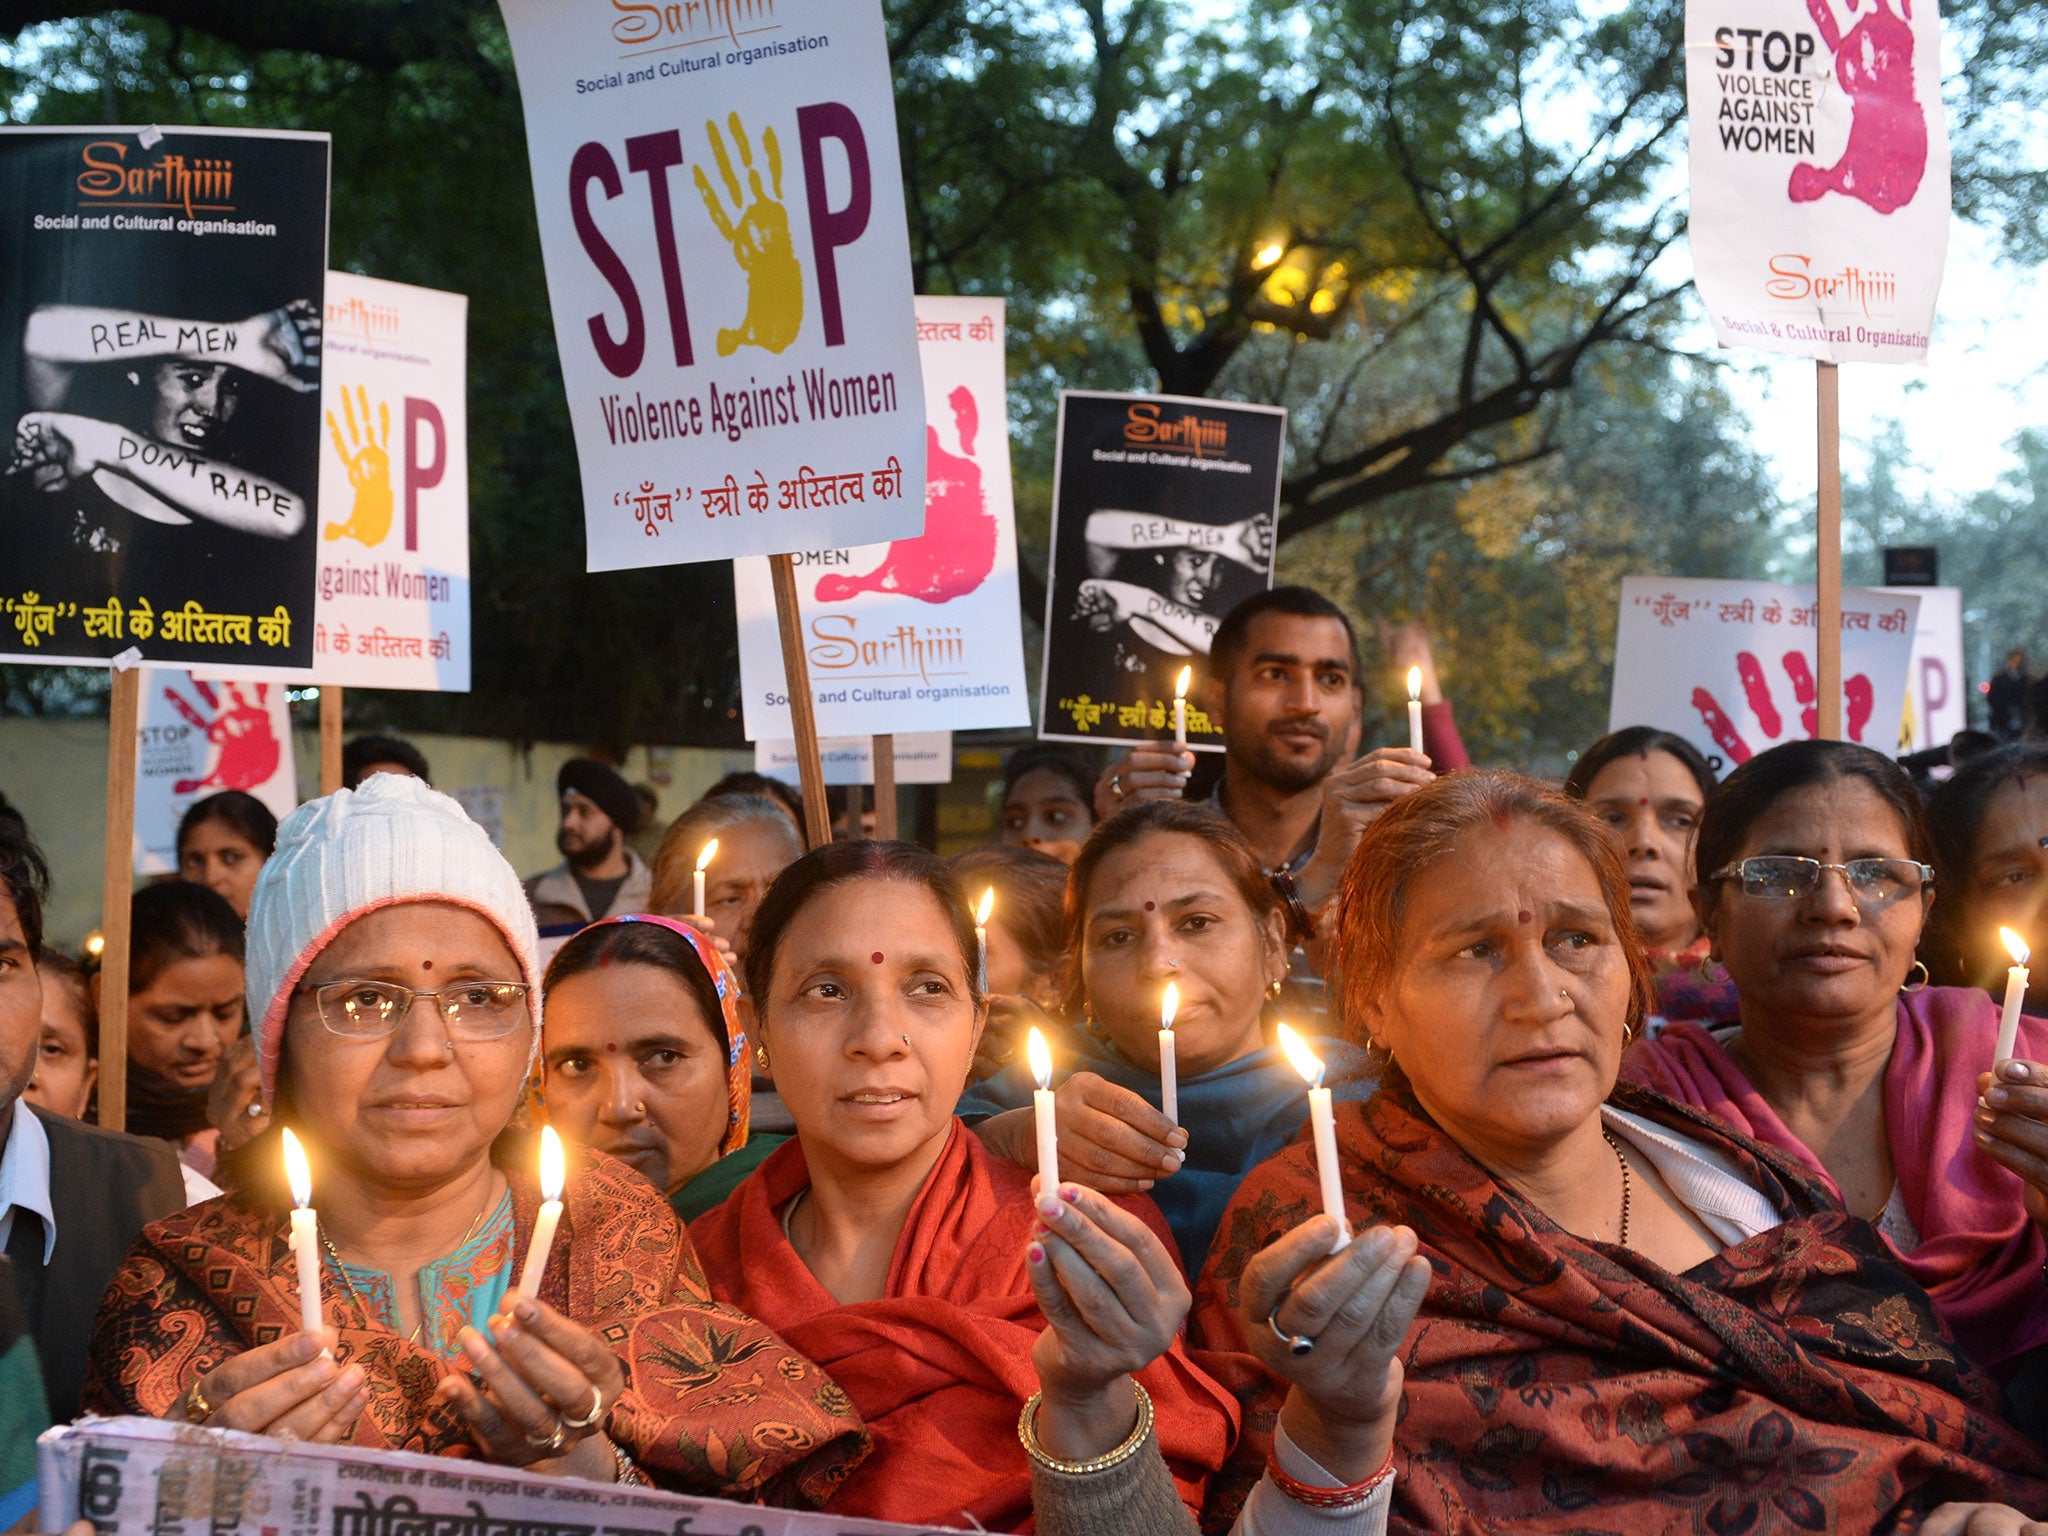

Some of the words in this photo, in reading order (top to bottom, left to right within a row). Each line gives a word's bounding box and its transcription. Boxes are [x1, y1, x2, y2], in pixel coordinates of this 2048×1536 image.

[576, 71, 623, 95] Social
[627, 65, 655, 84] and
[659, 52, 721, 78] Cultural
[726, 33, 829, 66] organisation
[1714, 26, 1815, 75] STOP
[1717, 74, 1812, 99] VIOLENCE
[1718, 98, 1814, 126] AGAINST
[1719, 125, 1815, 155] WOMEN
[76, 142, 233, 217] Sarthiiii
[34, 214, 79, 230] Social
[81, 214, 110, 230] and
[113, 215, 174, 232] Cultural
[177, 219, 277, 237] organisation
[1765, 253, 1896, 320] Sarthiiii
[91, 319, 167, 353] REAL
[176, 326, 238, 353] MEN
[968, 314, 994, 342] की
[1722, 315, 1769, 335] Social
[1770, 322, 1783, 338] &
[1786, 323, 1851, 342] Cultural
[1856, 326, 1929, 348] Organisatio
[599, 394, 702, 446] Violence
[710, 368, 799, 442] Against
[802, 367, 897, 428] Women
[1092, 449, 1126, 462] Social
[1127, 450, 1147, 463] and
[1148, 452, 1190, 467] Cultural
[1191, 458, 1252, 474] organisation
[211, 472, 292, 517] RAPE
[702, 474, 740, 518] स्त्री
[748, 470, 769, 512] के
[778, 465, 865, 511] अस्तित्व
[872, 455, 902, 500] की
[1131, 521, 1180, 544] REAL
[792, 549, 849, 566] OMEN
[318, 559, 379, 601] gainst
[385, 562, 450, 602] Women
[82, 596, 124, 639] स्त्री
[129, 596, 154, 640] के
[160, 600, 252, 645] अस्तित्व
[258, 605, 292, 648] की
[1762, 598, 1783, 626] के
[1877, 608, 1909, 635] की
[333, 623, 351, 654] के
[428, 630, 451, 661] की
[808, 615, 964, 686] Sarthiiii
[819, 689, 847, 704] and
[851, 687, 911, 702] Cultural
[916, 683, 1010, 701] organisation
[1149, 700, 1167, 730] के
[139, 725, 191, 744] STOP
